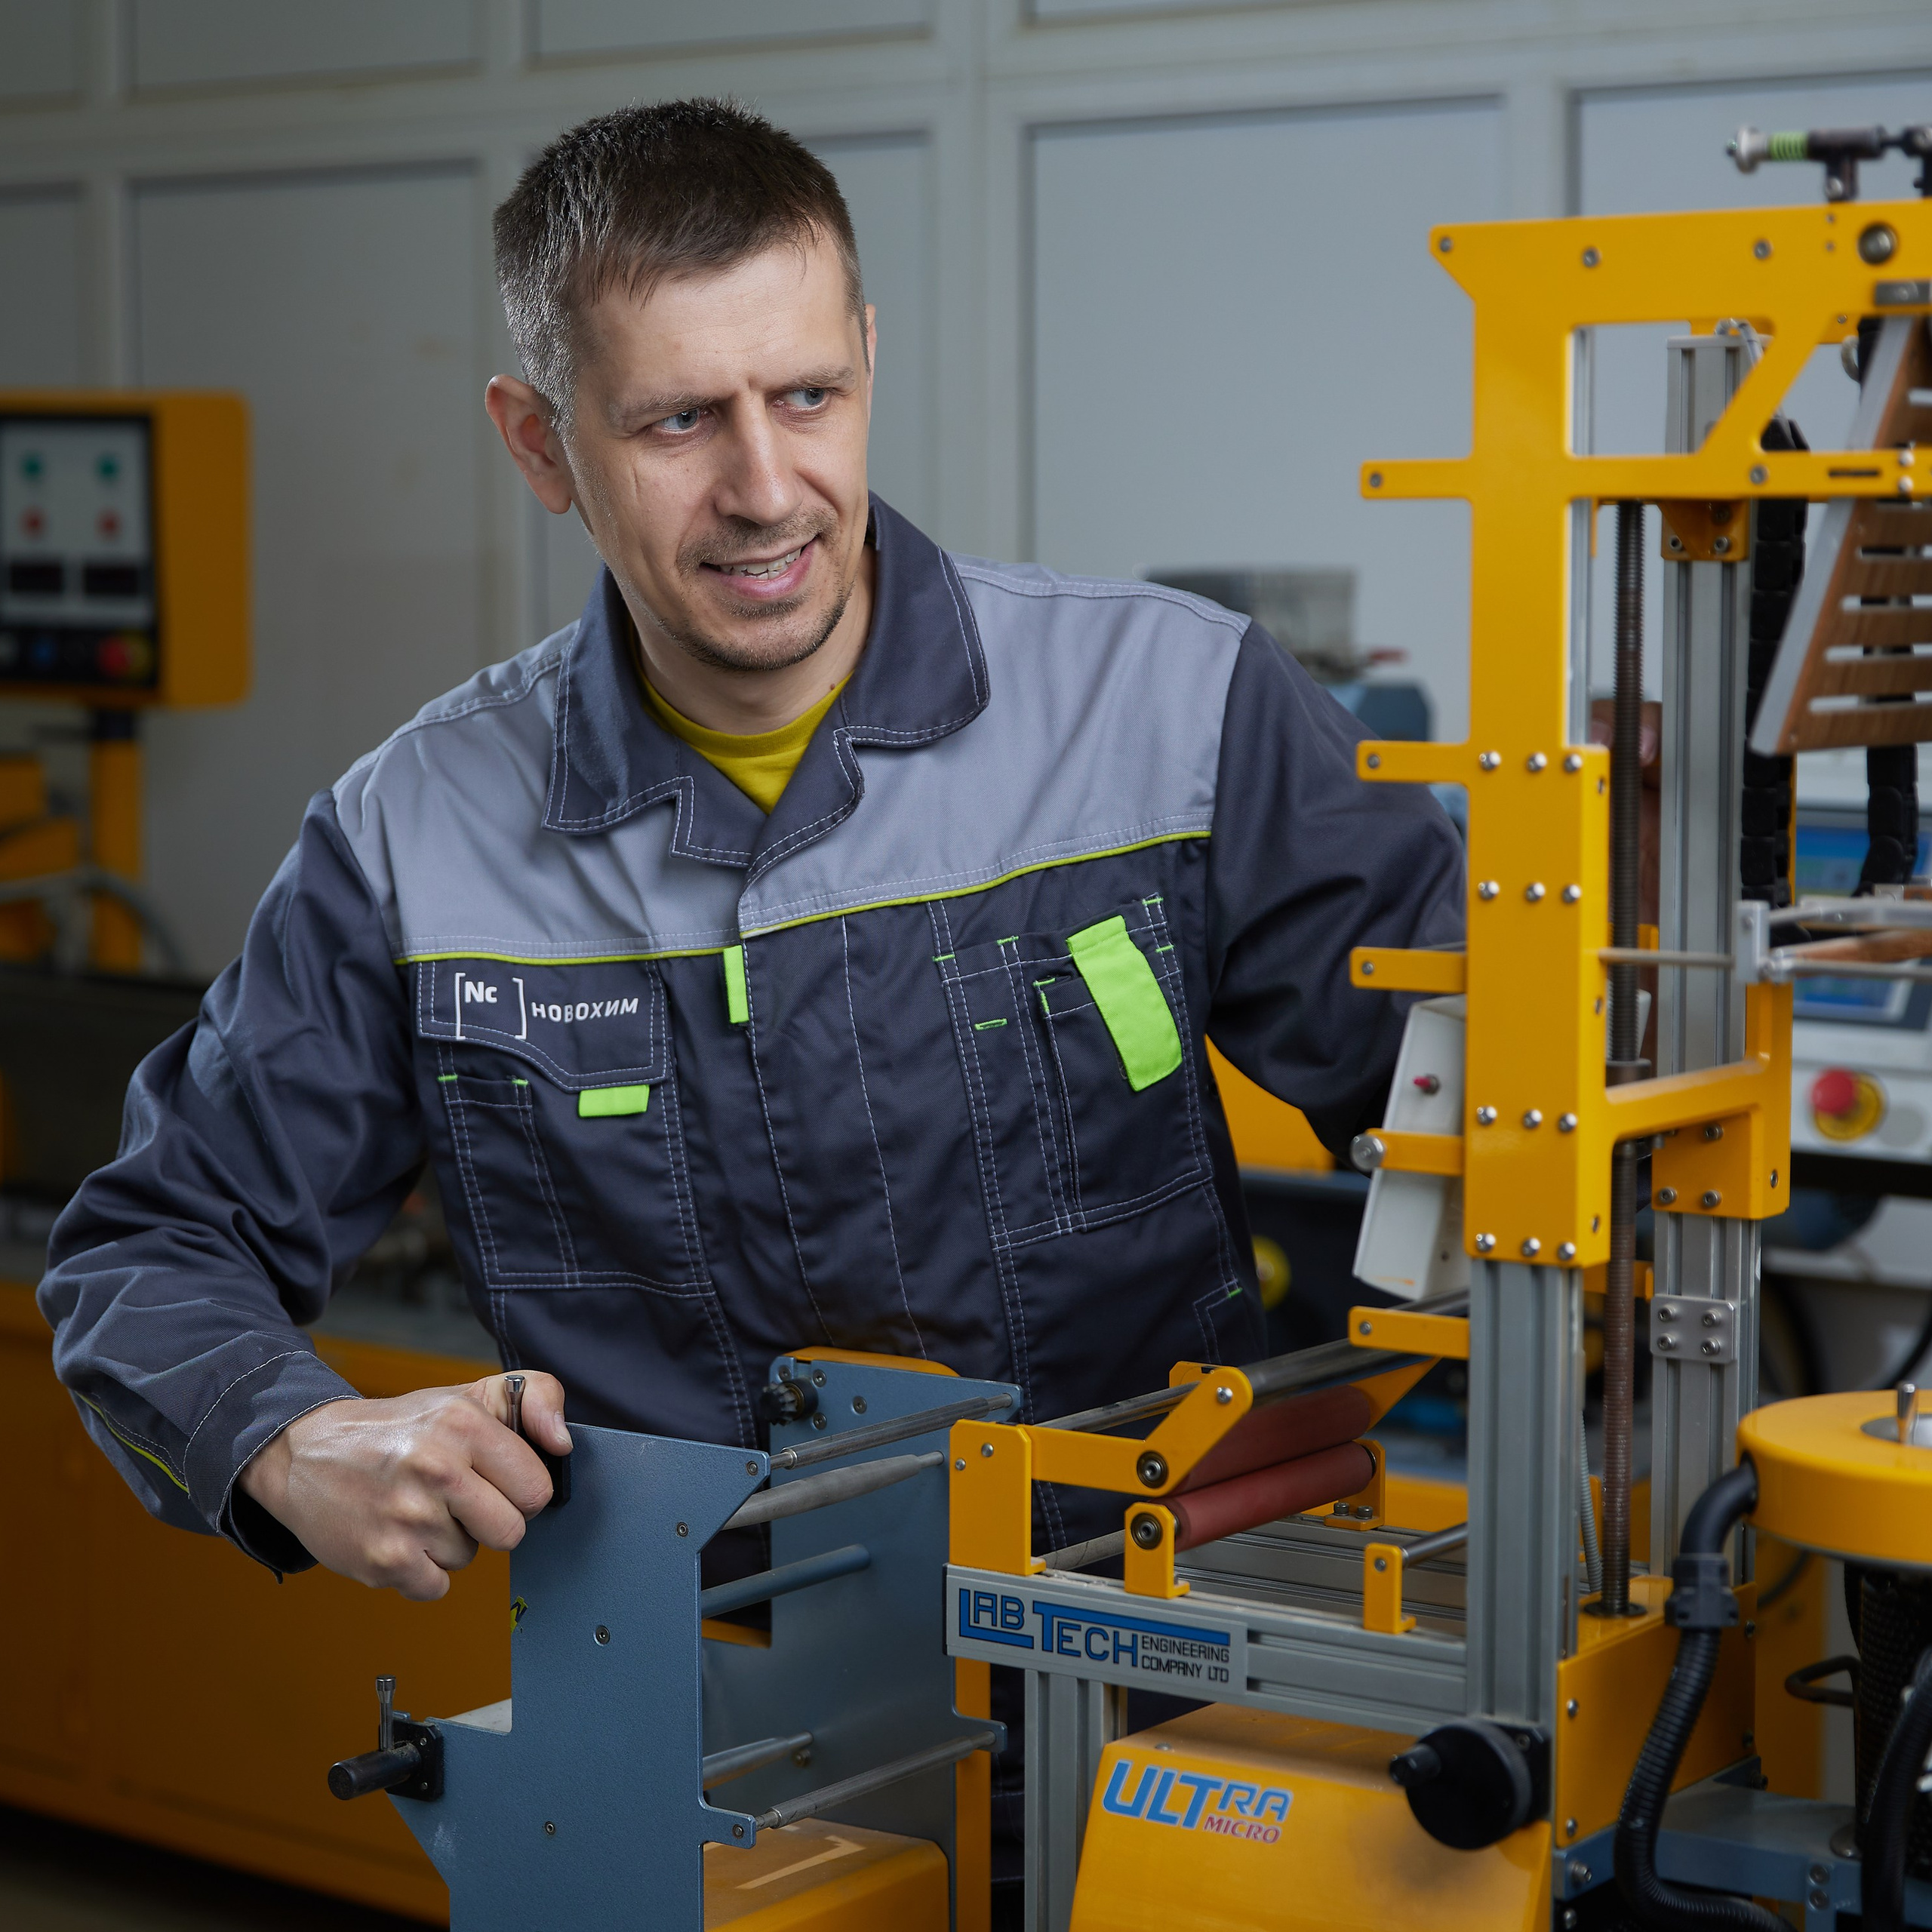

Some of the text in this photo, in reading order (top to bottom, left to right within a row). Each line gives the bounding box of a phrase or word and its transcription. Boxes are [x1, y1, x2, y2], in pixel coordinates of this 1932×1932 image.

[531, 998, 638, 1023] НОВОХИМ
[958, 1588, 1231, 1668] LAB TECH
[1141, 1635, 1230, 1663] ENGINEERING
[1141, 1655, 1230, 1683] COMPANY LTD
[1103, 1759, 1294, 1829] ULTRA
[1203, 1814, 1281, 1844] MICRO
